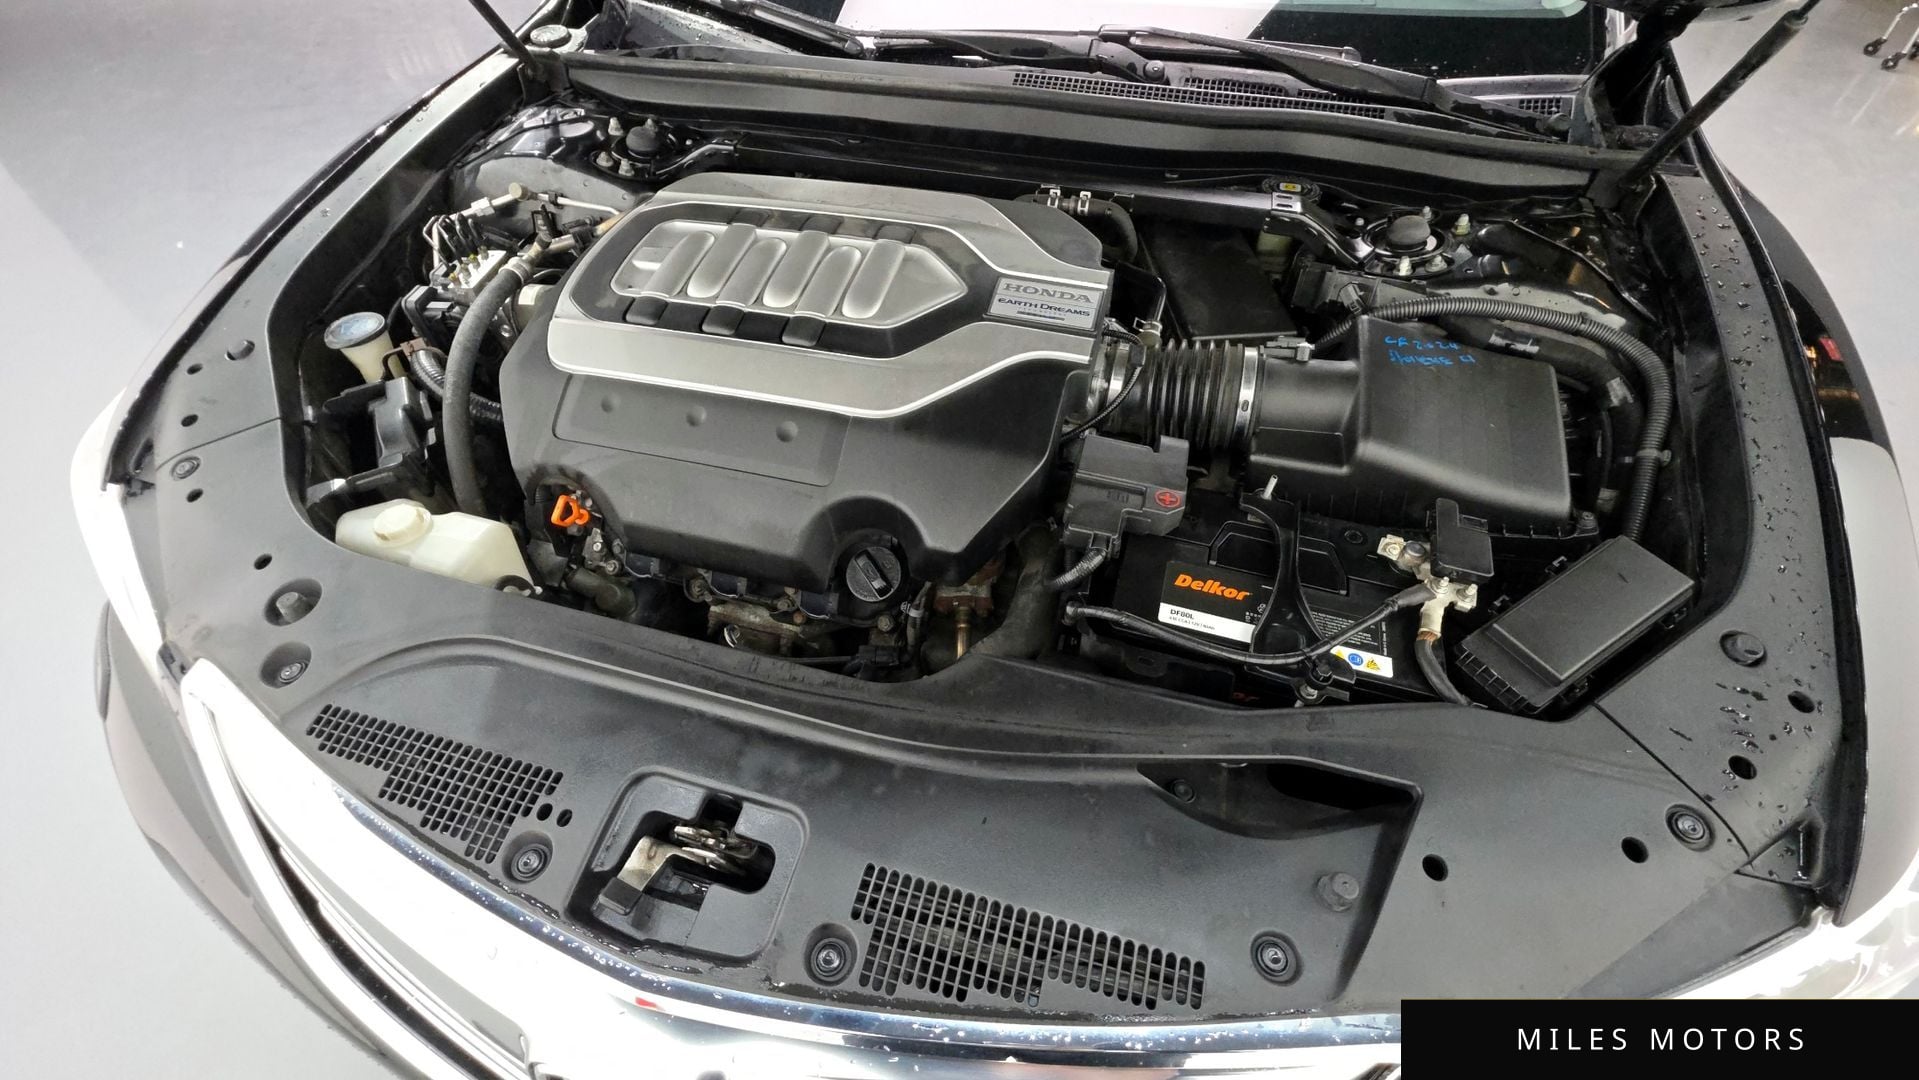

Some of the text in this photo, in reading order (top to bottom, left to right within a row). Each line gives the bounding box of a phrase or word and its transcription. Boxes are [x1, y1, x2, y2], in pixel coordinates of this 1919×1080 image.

[1003, 283, 1092, 303] HONDA
[998, 298, 1038, 308] EARTH
[1040, 303, 1090, 316] DREAMS
[1174, 574, 1249, 600] Delkor
